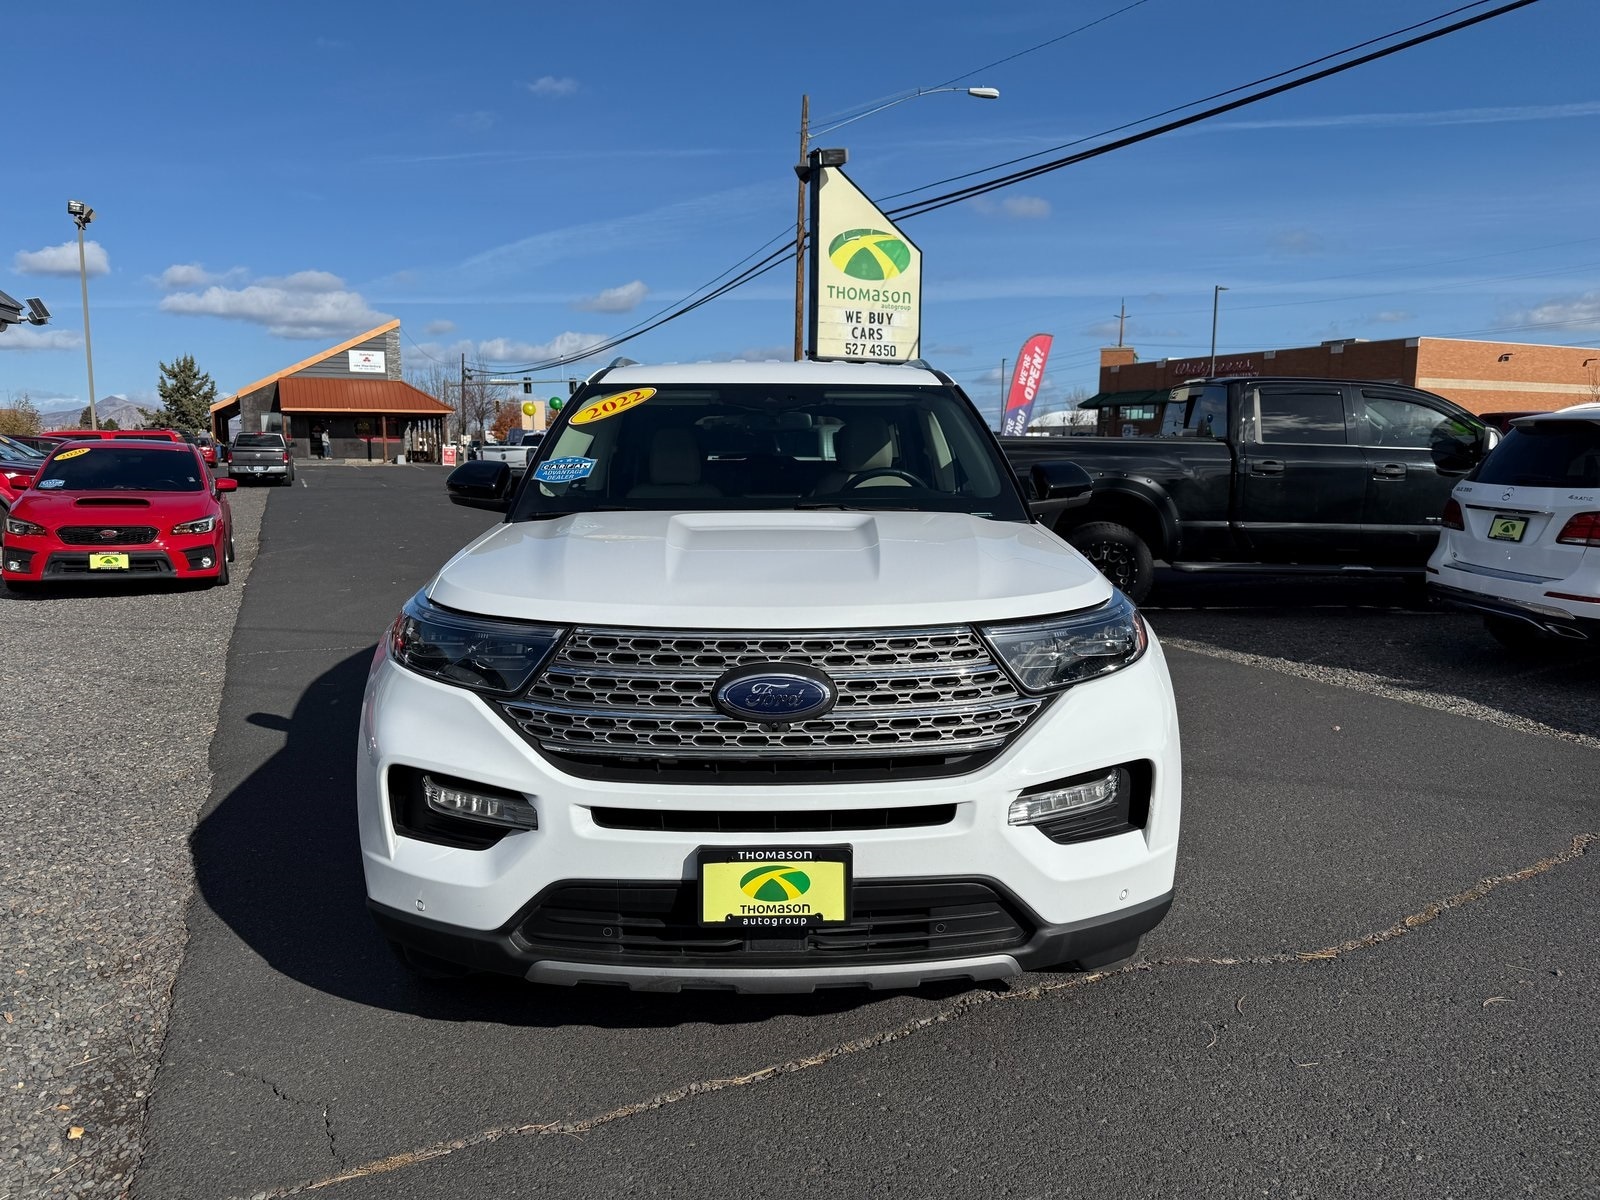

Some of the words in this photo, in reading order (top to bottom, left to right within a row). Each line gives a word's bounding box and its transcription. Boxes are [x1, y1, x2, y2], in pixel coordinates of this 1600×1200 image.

[881, 303, 911, 311] autogroup
[845, 310, 862, 323] WE
[868, 311, 893, 325] BUY
[851, 327, 883, 340] CARS
[845, 342, 866, 355] 527
[869, 344, 896, 357] 4350
[1018, 353, 1032, 386] WE'RE
[1024, 345, 1045, 401] OPEN!
[586, 391, 645, 419] 2022
[543, 462, 591, 470] CARFAX
[746, 682, 804, 708] Ford
[742, 917, 808, 927] autogroup
